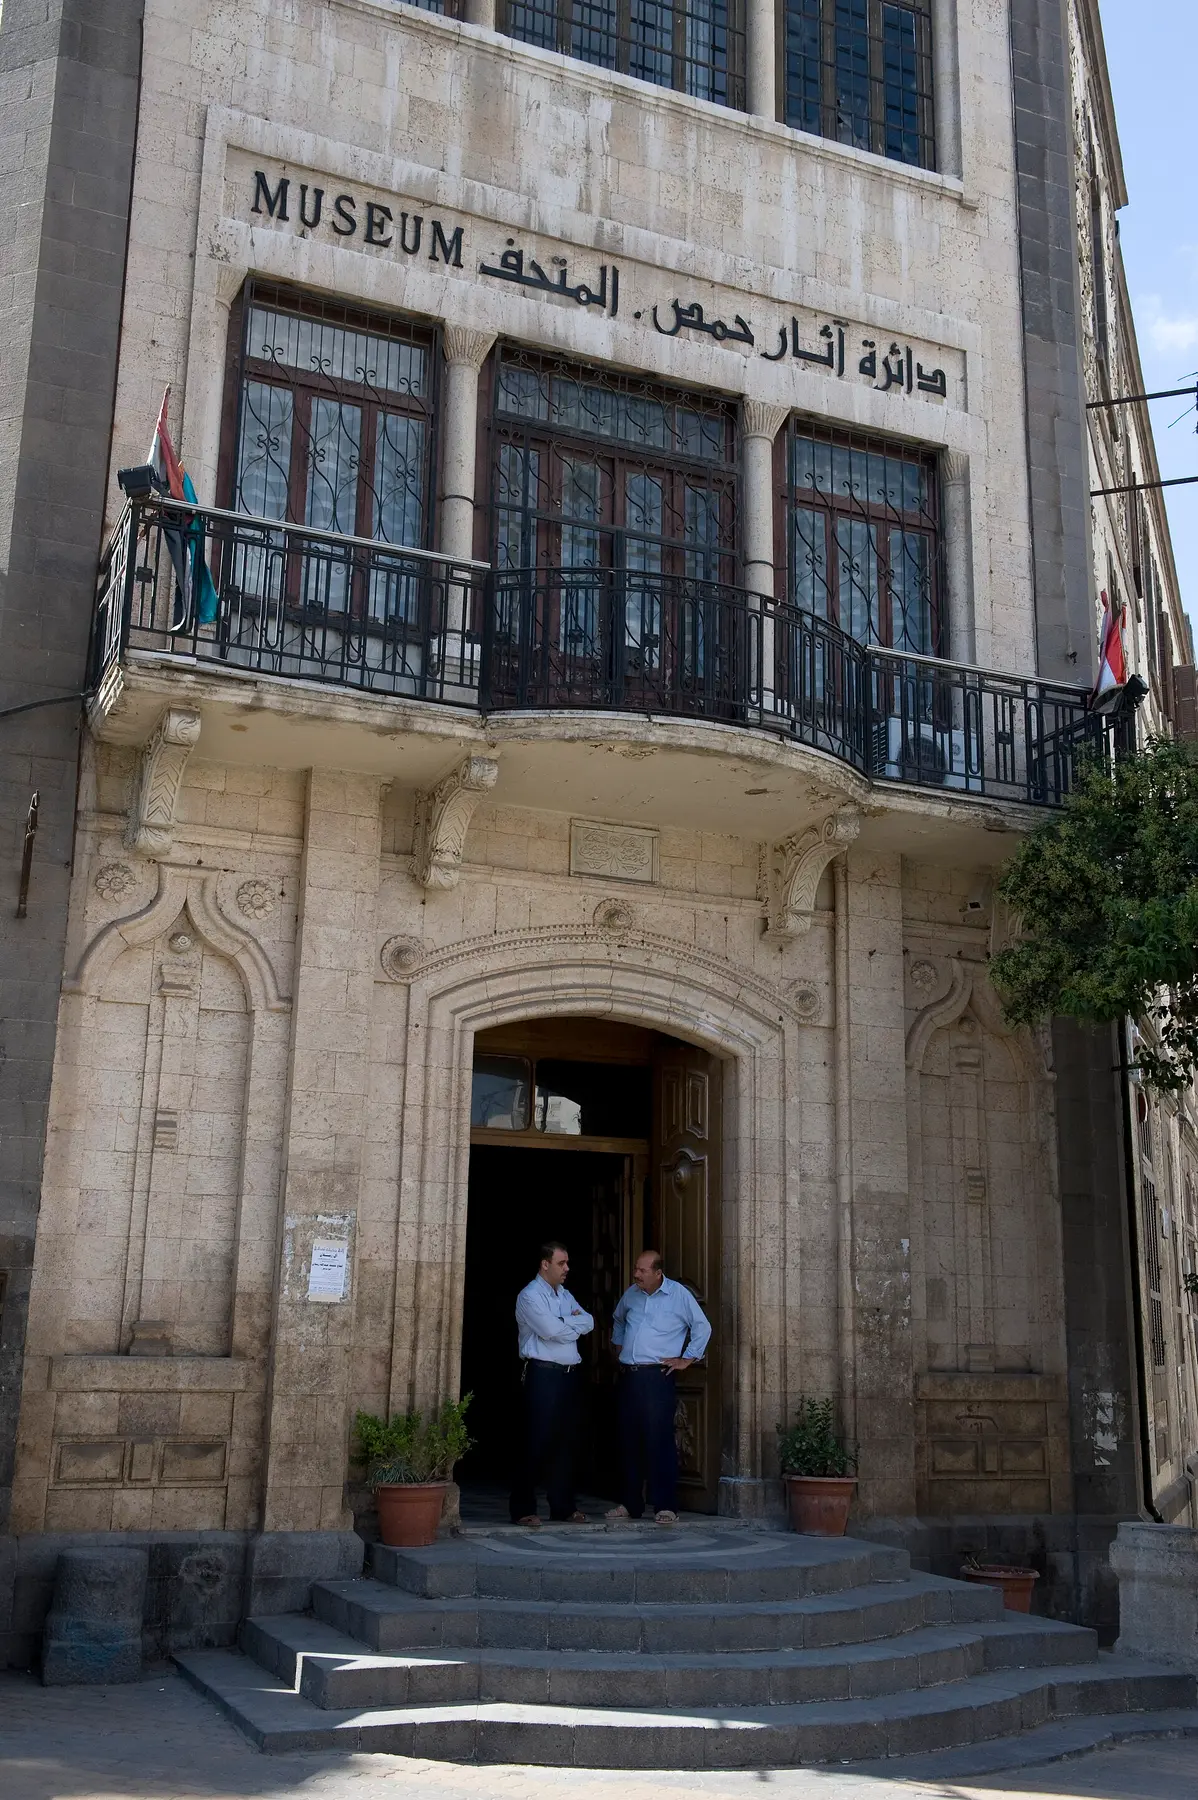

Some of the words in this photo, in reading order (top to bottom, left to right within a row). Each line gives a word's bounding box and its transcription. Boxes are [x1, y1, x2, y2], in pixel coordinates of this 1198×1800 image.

[250, 170, 464, 269] MUSEUM
[479, 238, 619, 317] المتحف
[652, 298, 754, 346] حمص
[761, 316, 849, 377] آثار
[859, 339, 947, 397] دائرة
